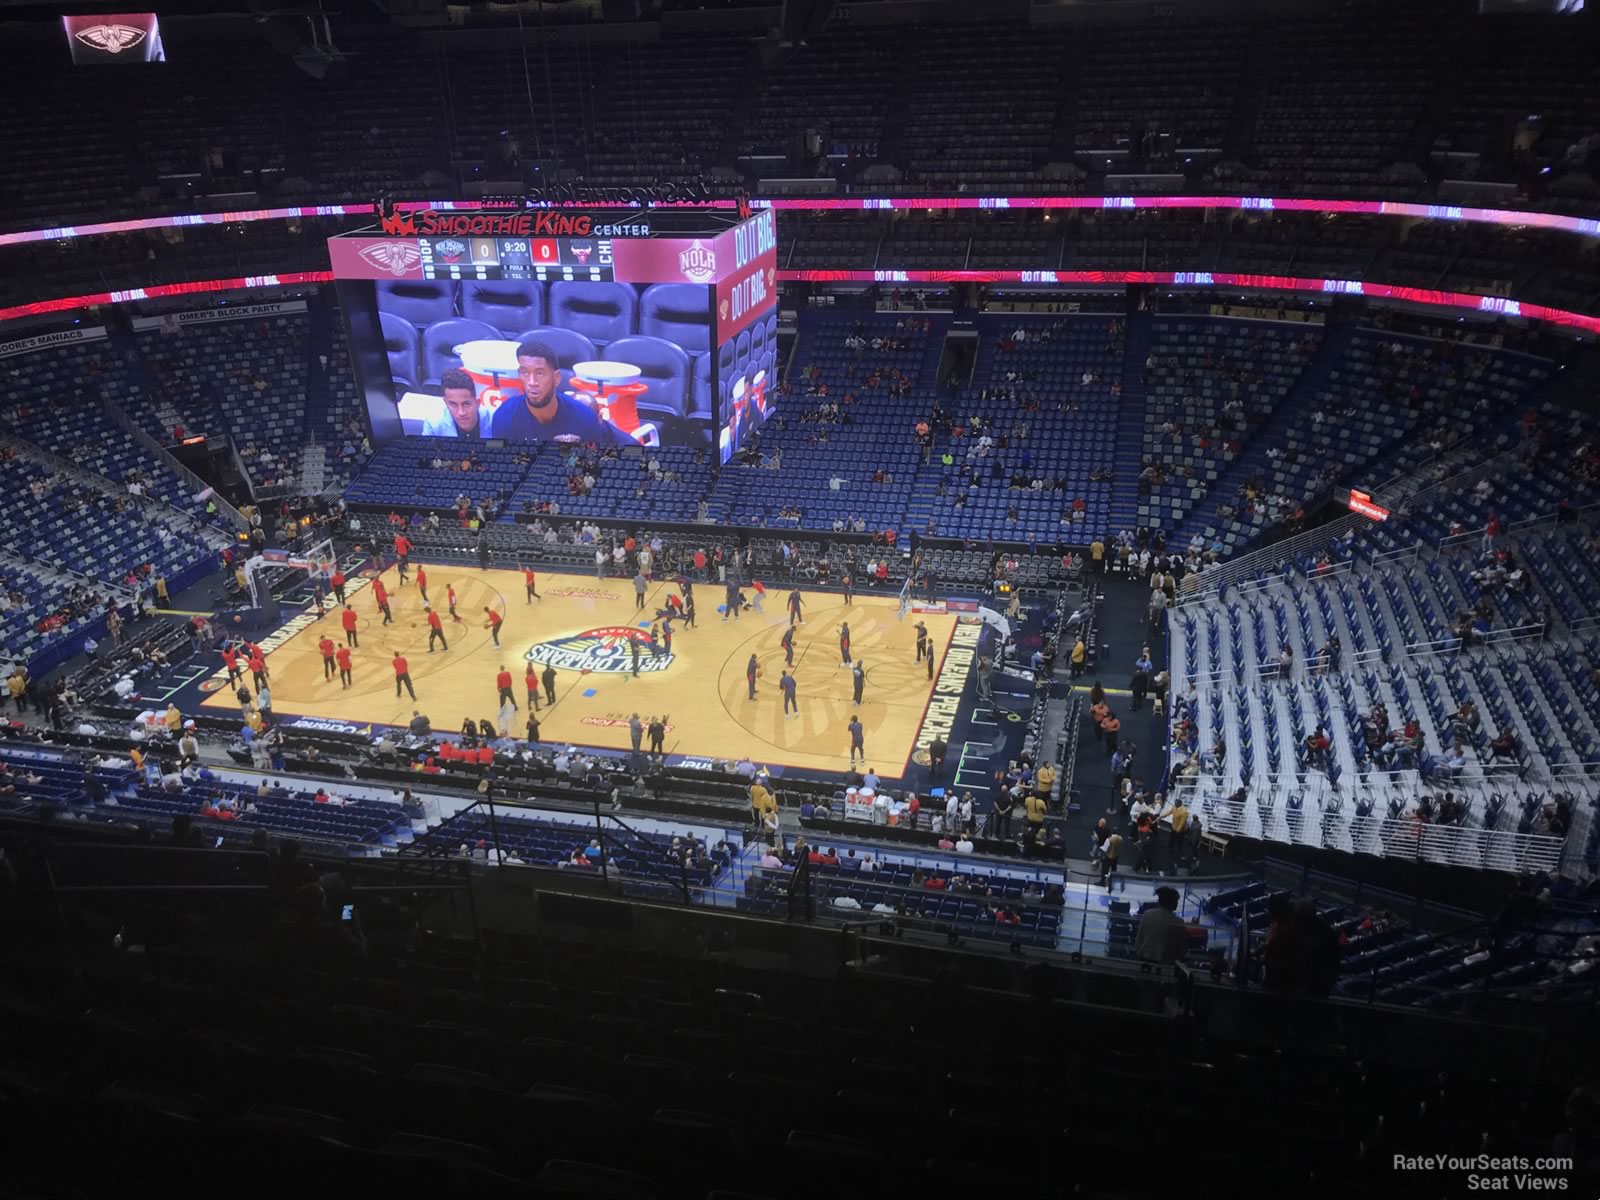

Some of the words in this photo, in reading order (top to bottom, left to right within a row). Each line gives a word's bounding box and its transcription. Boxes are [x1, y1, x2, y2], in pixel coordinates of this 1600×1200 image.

[863, 199, 872, 208] DO
[879, 200, 893, 208] BIG.
[979, 198, 988, 207] DO
[995, 198, 1010, 208] BIG.
[1103, 197, 1112, 207] DO
[1120, 198, 1136, 207] BIG.
[421, 210, 533, 235] SMOOTHIE
[594, 224, 649, 236] CENTER
[504, 241, 526, 252] 9:20
[735, 224, 748, 270] DO
[748, 219, 757, 262] IT
[757, 211, 776, 256] BIG.
[420, 239, 433, 263] NOP
[480, 244, 489, 258] 0
[541, 244, 550, 258] 0
[597, 240, 612, 264] CHI
[681, 250, 716, 271] NOLA
[245, 277, 256, 287] DO
[256, 276, 263, 286] IT
[263, 275, 280, 285] BIG.
[874, 270, 884, 281] DO
[885, 270, 892, 281] IT
[892, 271, 909, 281] BIG.
[1021, 271, 1031, 281] DO
[1031, 271, 1040, 281] IT
[1040, 271, 1058, 282] BIG.
[1174, 272, 1185, 283] DO
[1186, 272, 1194, 283] IT
[1324, 280, 1335, 291] DO
[1336, 280, 1345, 292] IT
[1345, 281, 1364, 294] BIG.
[111, 291, 122, 302] DO
[122, 290, 131, 301] IT
[130, 288, 148, 300] BIG.
[732, 283, 742, 321] DO
[743, 278, 751, 313] IT
[751, 269, 767, 307] BIG.
[179, 310, 215, 321] OMER'S
[218, 306, 250, 317] BLOCK
[251, 304, 281, 314] PARTY
[1482, 296, 1494, 309] DO
[1495, 298, 1505, 311] IT
[1504, 299, 1521, 314] BIG.
[0, 338, 36, 352] OORE'S
[39, 330, 83, 345] MANIACS
[951, 624, 982, 648] NEW
[526, 644, 614, 671] ORLEANS
[935, 648, 975, 693] ORLEANS
